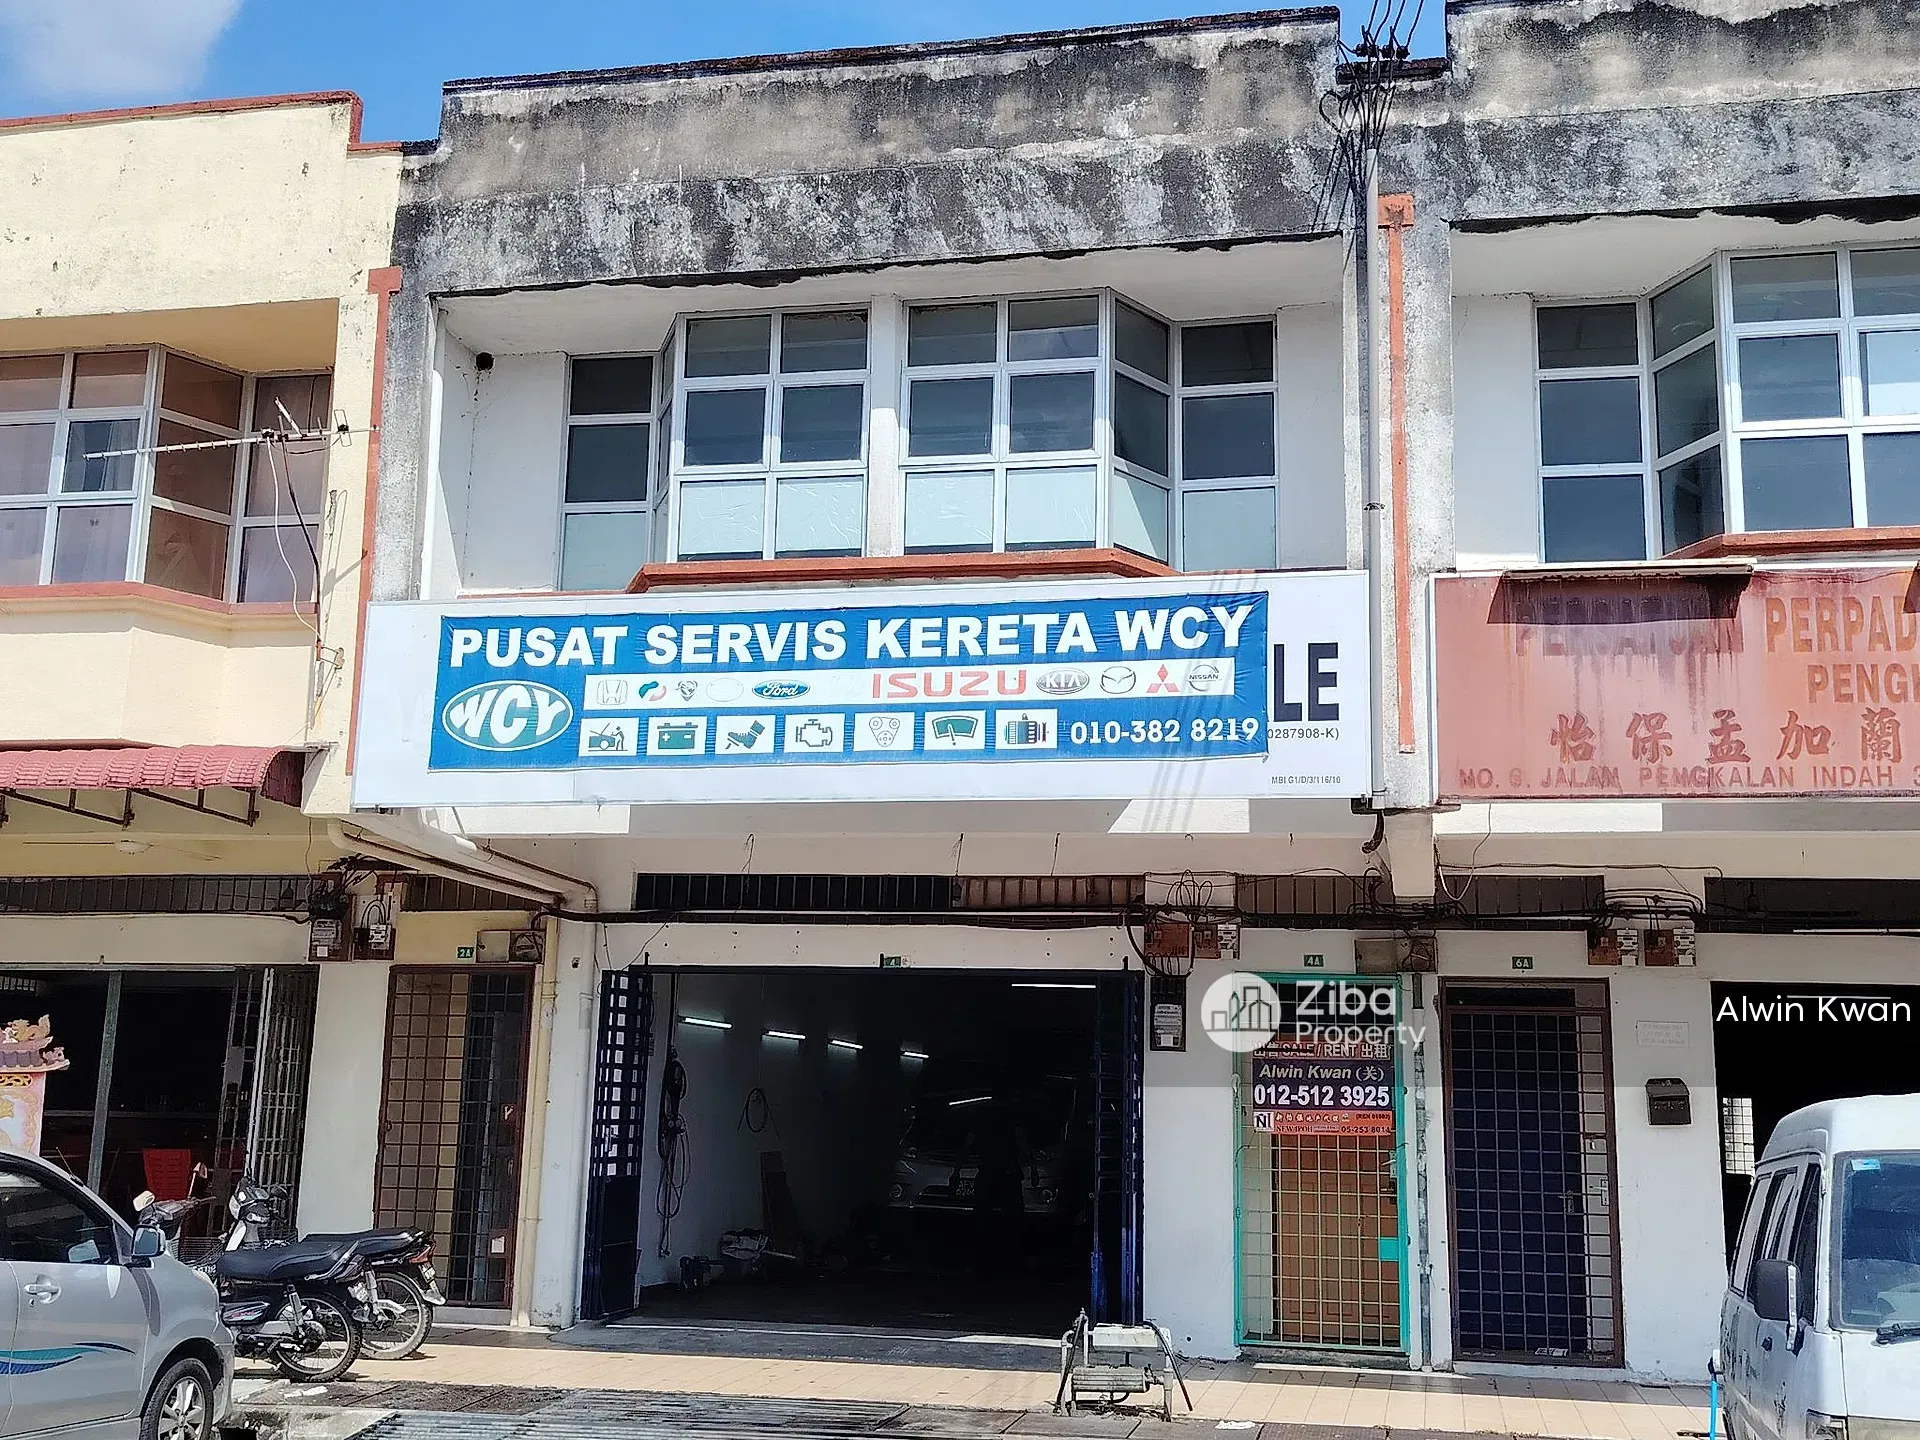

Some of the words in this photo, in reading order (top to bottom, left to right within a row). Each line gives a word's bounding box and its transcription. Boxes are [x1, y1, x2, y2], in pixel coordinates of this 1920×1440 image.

[449, 625, 629, 668] PUSAT
[644, 619, 847, 664] SERVIS
[866, 611, 1097, 660] KERETA
[1114, 604, 1255, 652] WCY
[871, 669, 1027, 700] ISUZU
[1044, 673, 1081, 689] KIA
[1188, 673, 1219, 681] NISSAN
[762, 680, 800, 698] Ford
[449, 683, 569, 744] WCY
[1069, 718, 1181, 744] 010-382
[1190, 716, 1260, 743] 8219
[1267, 727, 1340, 741] 0287908-K)
[1541, 766, 1621, 789] JALAN
[1639, 765, 1795, 789] PENGKALAN
[1812, 764, 1894, 788] INDAH
[458, 948, 472, 958] 2A
[1306, 955, 1321, 966] 4A
[1514, 957, 1531, 968] 6A
[1323, 1043, 1357, 1057] RENT
[1360, 1043, 1389, 1058] 出租
[1258, 1064, 1303, 1079] Alwin
[1307, 1065, 1352, 1079] Kwan
[1253, 1084, 1334, 1106] 012-512
[1339, 1085, 1391, 1106] 3925
